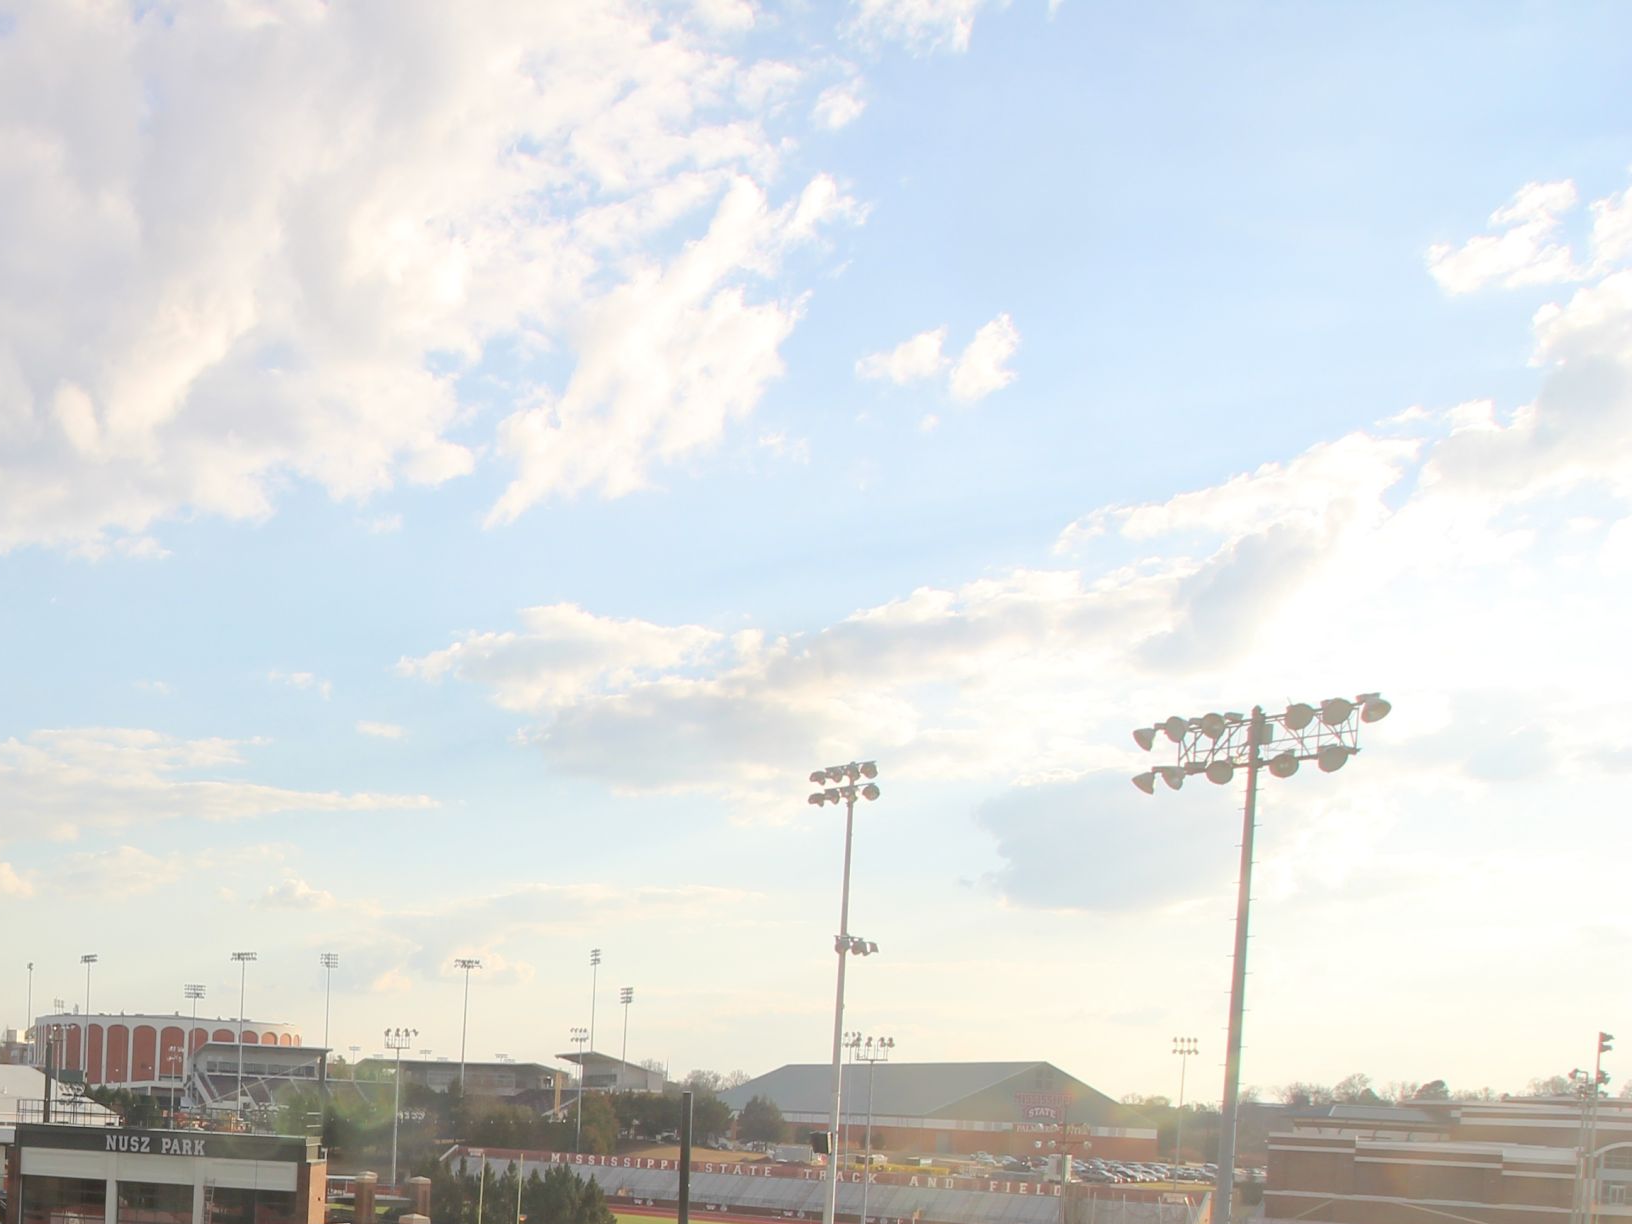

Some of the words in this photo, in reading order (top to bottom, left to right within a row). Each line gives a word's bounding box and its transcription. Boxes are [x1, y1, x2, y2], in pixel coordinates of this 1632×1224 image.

[1028, 1107, 1057, 1119] STATE
[105, 1134, 150, 1153] NUSZ
[161, 1137, 205, 1156] PARK
[705, 1162, 772, 1177] STATE
[804, 1168, 878, 1184] TRACK
[909, 1175, 954, 1189] AND
[989, 1181, 1062, 1196] FIELD
